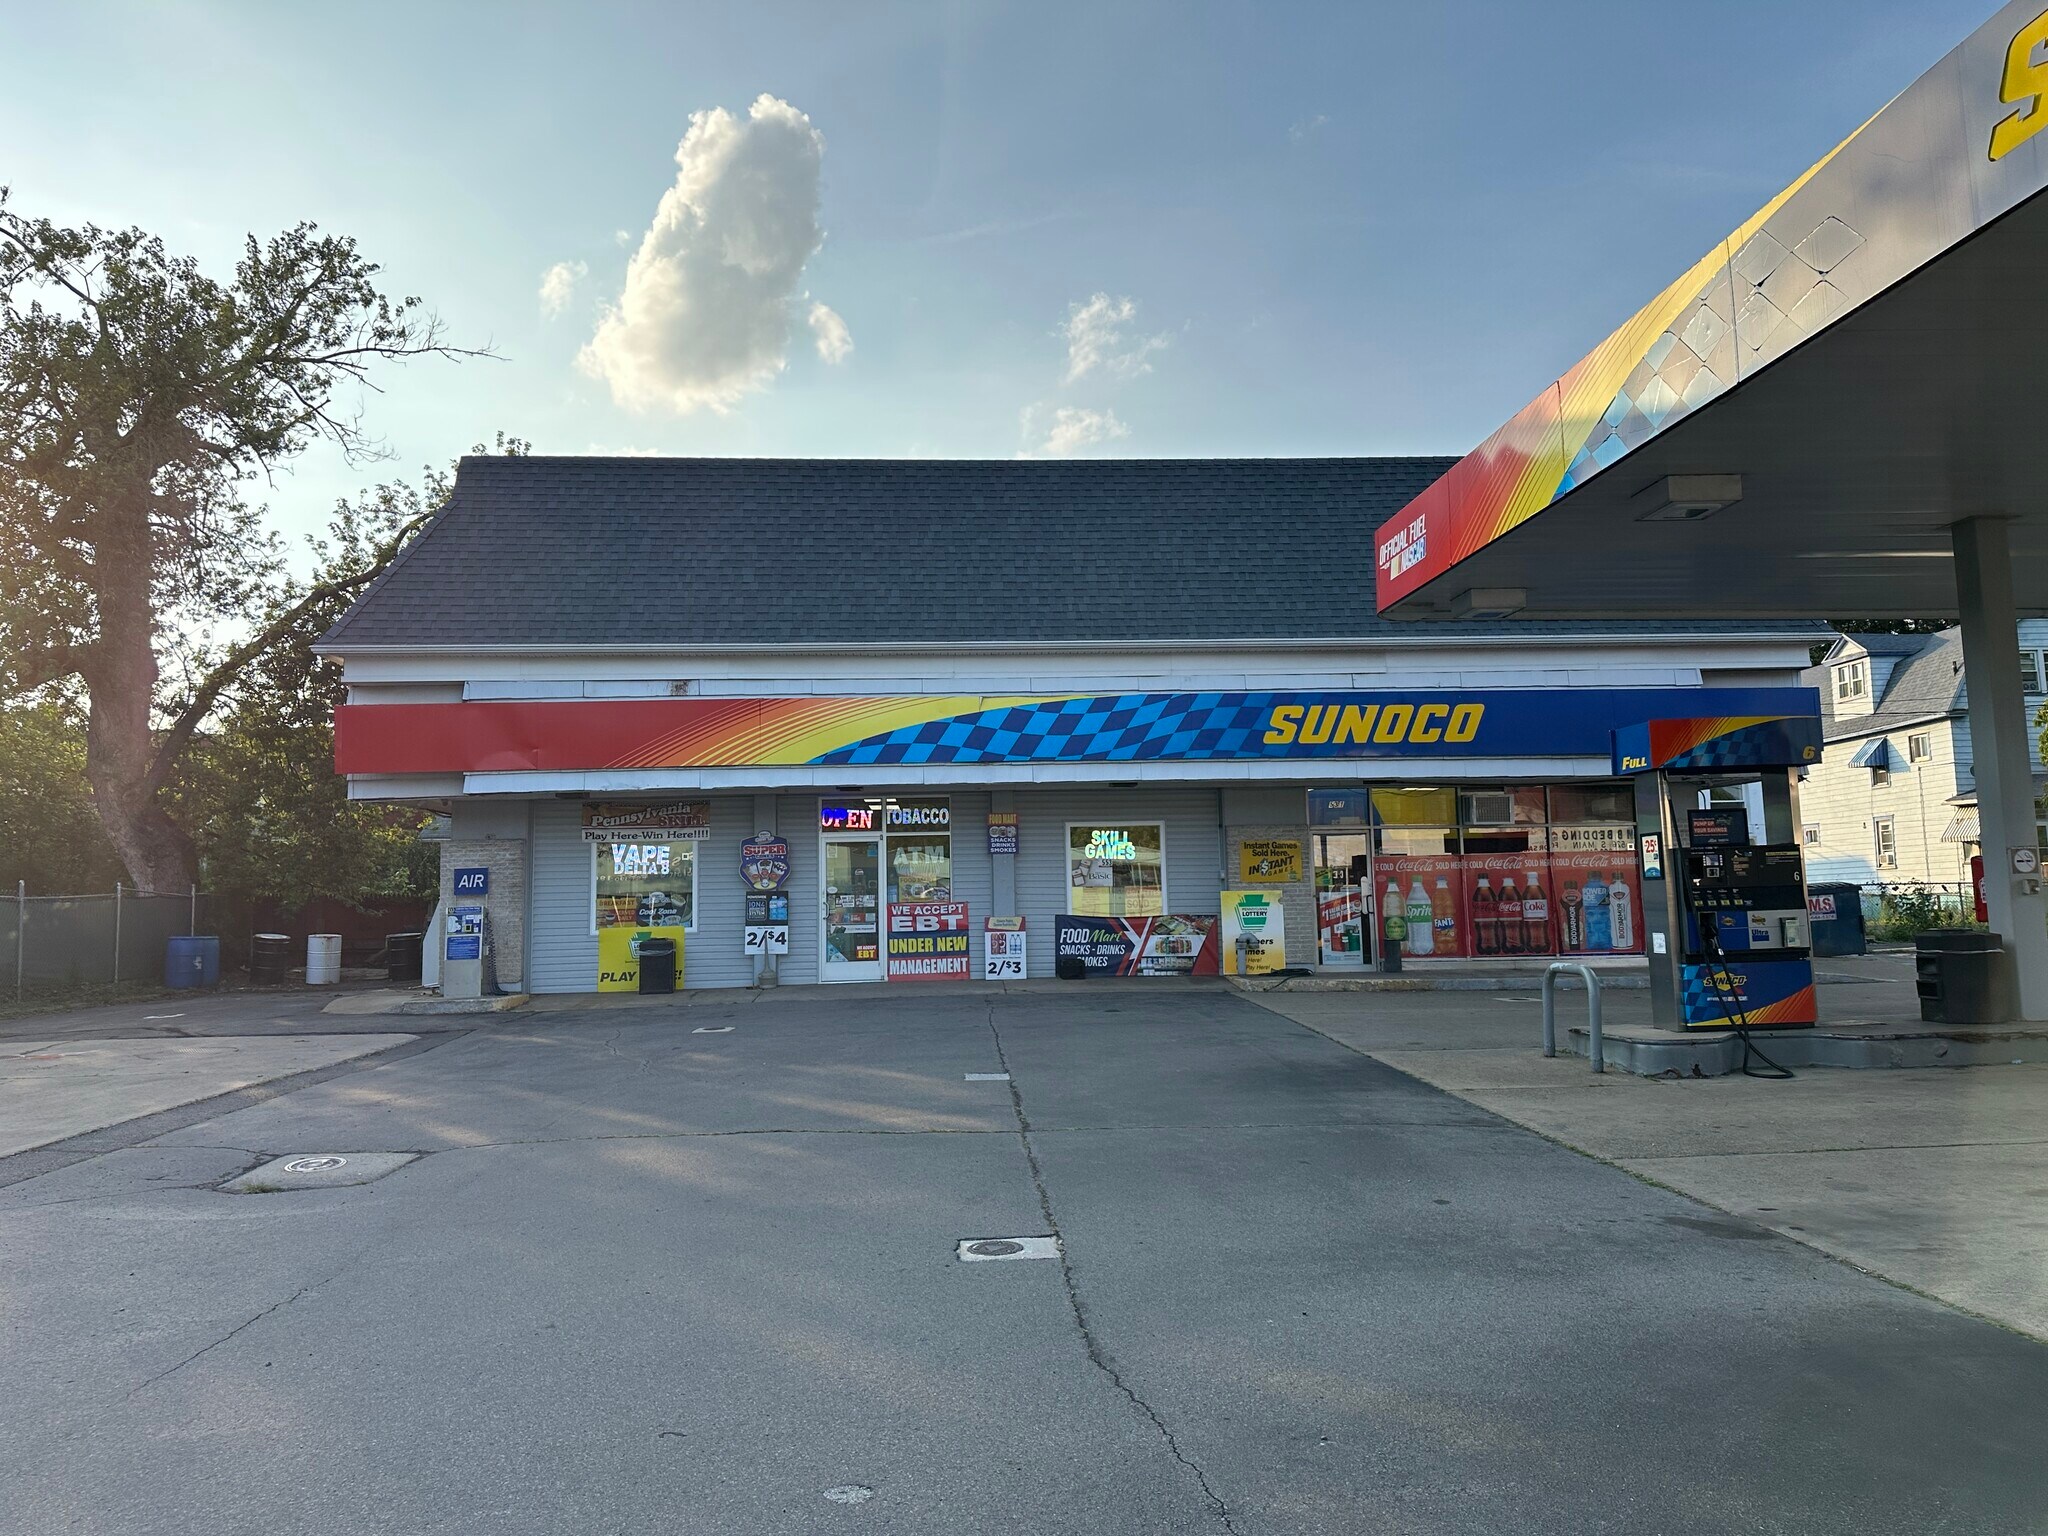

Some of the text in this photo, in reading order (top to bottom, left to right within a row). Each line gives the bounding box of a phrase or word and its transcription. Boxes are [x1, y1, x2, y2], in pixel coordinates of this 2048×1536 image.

[1380, 513, 1427, 567] OFFICIAL FUEL
[1263, 703, 1485, 744] SUNOCO
[1803, 746, 1815, 760] 6
[1622, 756, 1648, 771] FULL
[591, 802, 692, 827] Pennsylvania
[821, 807, 873, 829] OPEN
[886, 808, 949, 825] TOBACCO
[585, 831, 608, 842] Play
[667, 829, 709, 839] Here!!!!
[1090, 830, 1133, 845] SKILL
[743, 844, 787, 856] SUPER
[1084, 843, 1136, 860] GAMES
[1252, 849, 1269, 857] Sold
[1271, 842, 1298, 850] Games
[611, 843, 671, 865] VAPE
[893, 845, 944, 864] ATM
[1555, 858, 1570, 866] COLD
[1571, 854, 1609, 867] Coca-Cola
[1611, 857, 1625, 865] SOLD
[614, 861, 658, 875] DELTA
[661, 860, 670, 875] 8
[1380, 862, 1394, 871] COLD
[1395, 859, 1433, 872] Coca-Cola
[1435, 861, 1449, 869] SOLD
[1469, 861, 1483, 869] COLD
[1484, 856, 1523, 870] Coca-Cola
[1524, 859, 1538, 867] SOLD
[1089, 872, 1111, 880] Basic
[1267, 867, 1294, 877] GAMES
[1793, 871, 1800, 881] 6
[458, 874, 484, 888] AIR
[639, 908, 657, 916] Cool
[891, 903, 964, 916] WE ACCEPT
[1523, 901, 1545, 911] Coke
[891, 914, 964, 933] EBT
[746, 930, 787, 948] 2/$4
[1060, 928, 1124, 944] FOOD Mart
[888, 936, 967, 954] UNDER NEW
[1060, 944, 1091, 955] SNACKS
[1097, 944, 1126, 955] DRINKS
[858, 950, 875, 959] EBT
[889, 957, 968, 976] MANAGEMENT
[988, 960, 1022, 977] 2/$3
[600, 971, 637, 983] PLAY
